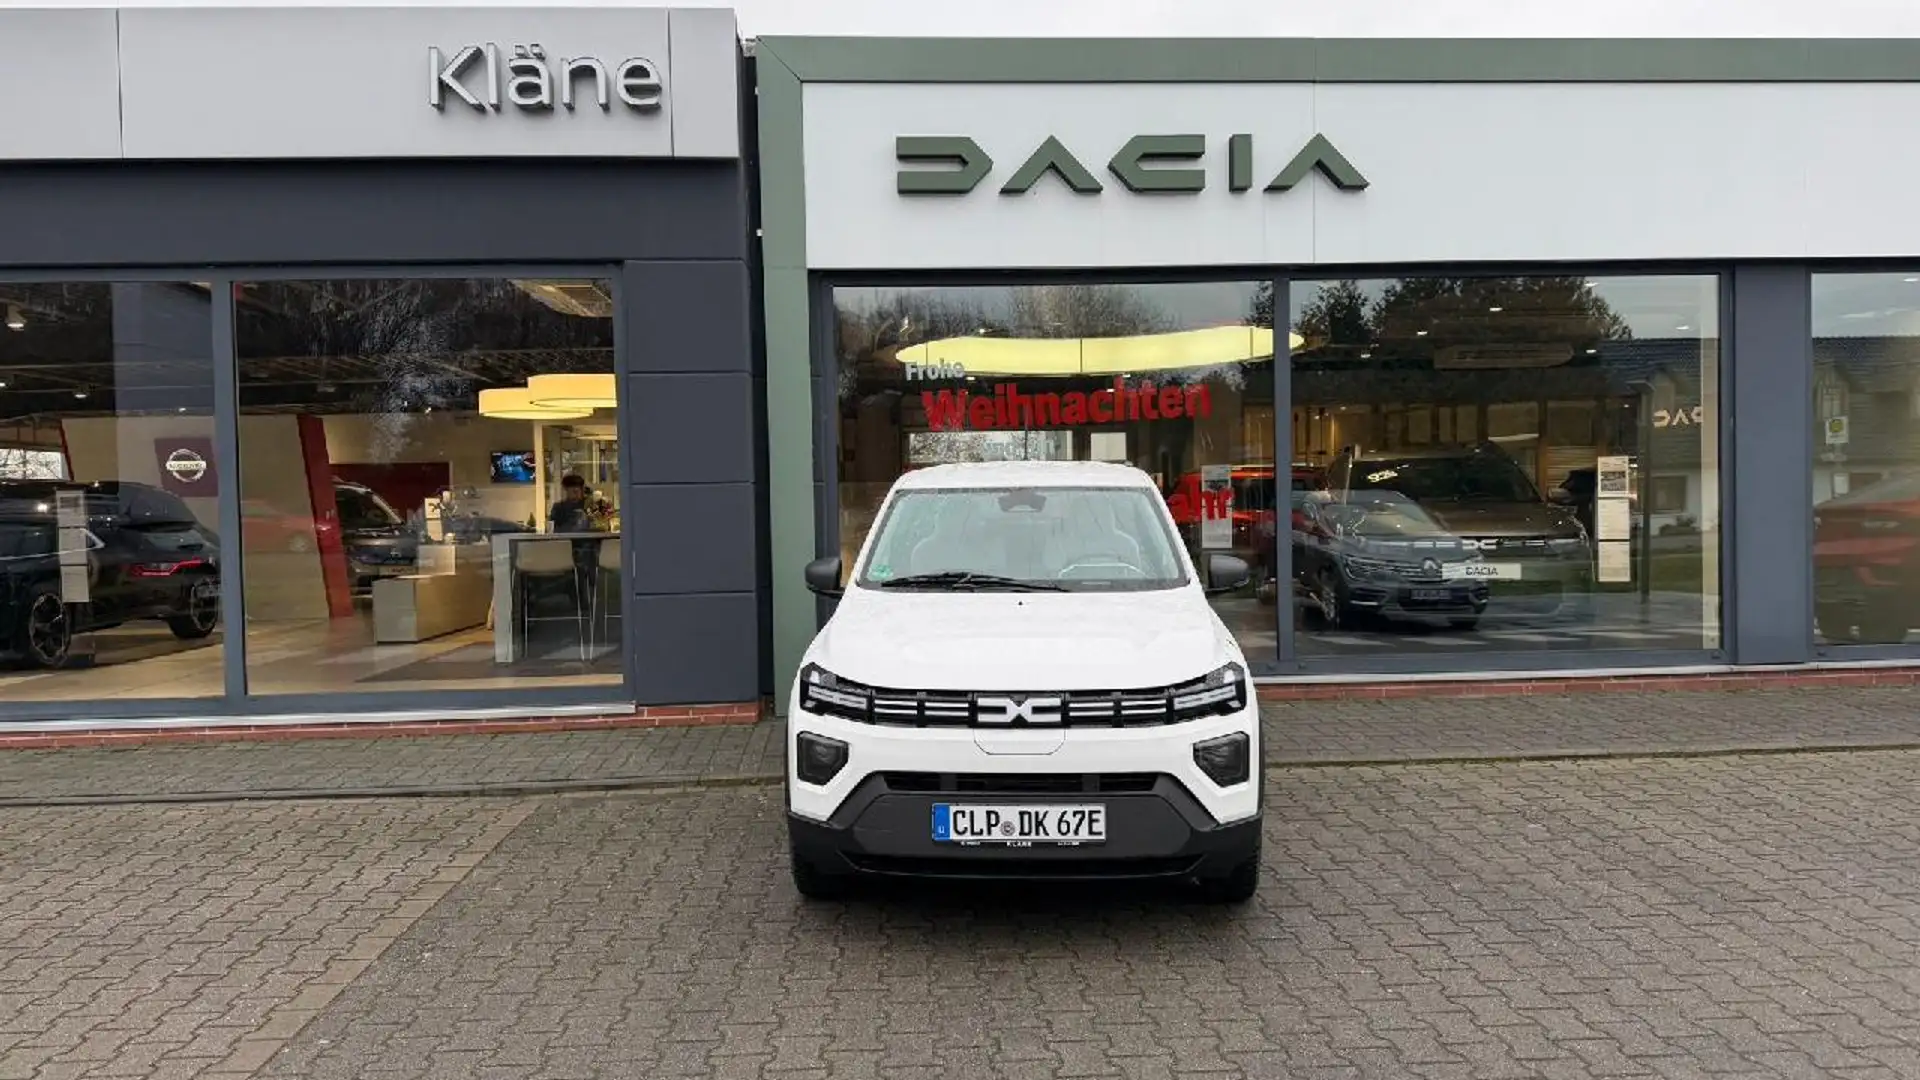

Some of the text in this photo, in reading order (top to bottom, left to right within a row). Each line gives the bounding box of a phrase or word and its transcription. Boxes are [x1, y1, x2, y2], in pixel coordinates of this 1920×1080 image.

[428, 42, 663, 113] Kläne
[896, 133, 1369, 195] DACIA
[905, 357, 965, 381] Frohe
[921, 375, 1212, 432] Weihnachten
[1465, 566, 1499, 577] DACIA
[953, 810, 1104, 836] CLP DK 67E
